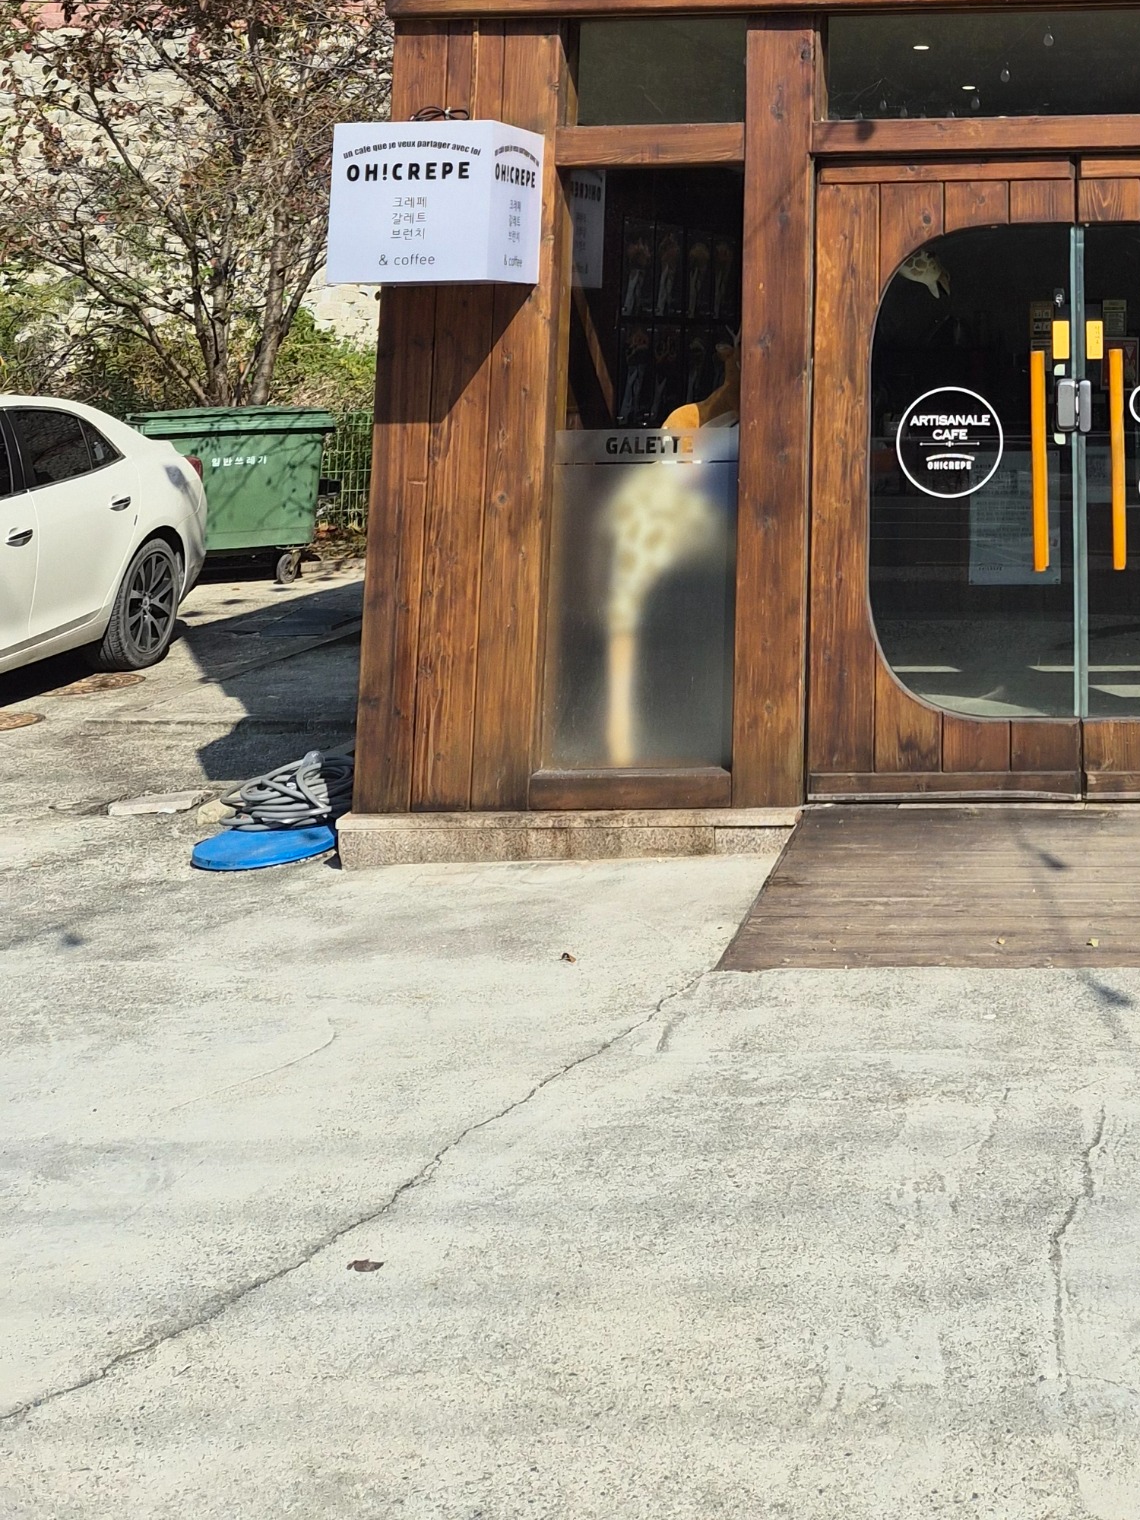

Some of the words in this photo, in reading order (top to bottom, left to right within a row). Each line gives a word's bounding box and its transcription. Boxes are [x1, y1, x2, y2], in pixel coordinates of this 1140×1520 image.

[343, 150, 354, 160] un
[373, 142, 387, 152] que
[398, 140, 416, 148] veux
[417, 140, 451, 150] partager
[452, 143, 470, 153] avec
[346, 161, 471, 182] OH!CREPE
[494, 162, 536, 189] OH!CREPE
[392, 196, 427, 208] 크레페
[391, 212, 427, 225] 갈레트
[390, 228, 426, 241] 브런치
[378, 254, 388, 266] &
[393, 253, 435, 266] coffee
[910, 414, 991, 427] ARTISANALE
[932, 429, 968, 440] CAFE
[605, 435, 694, 455] GALETTE
